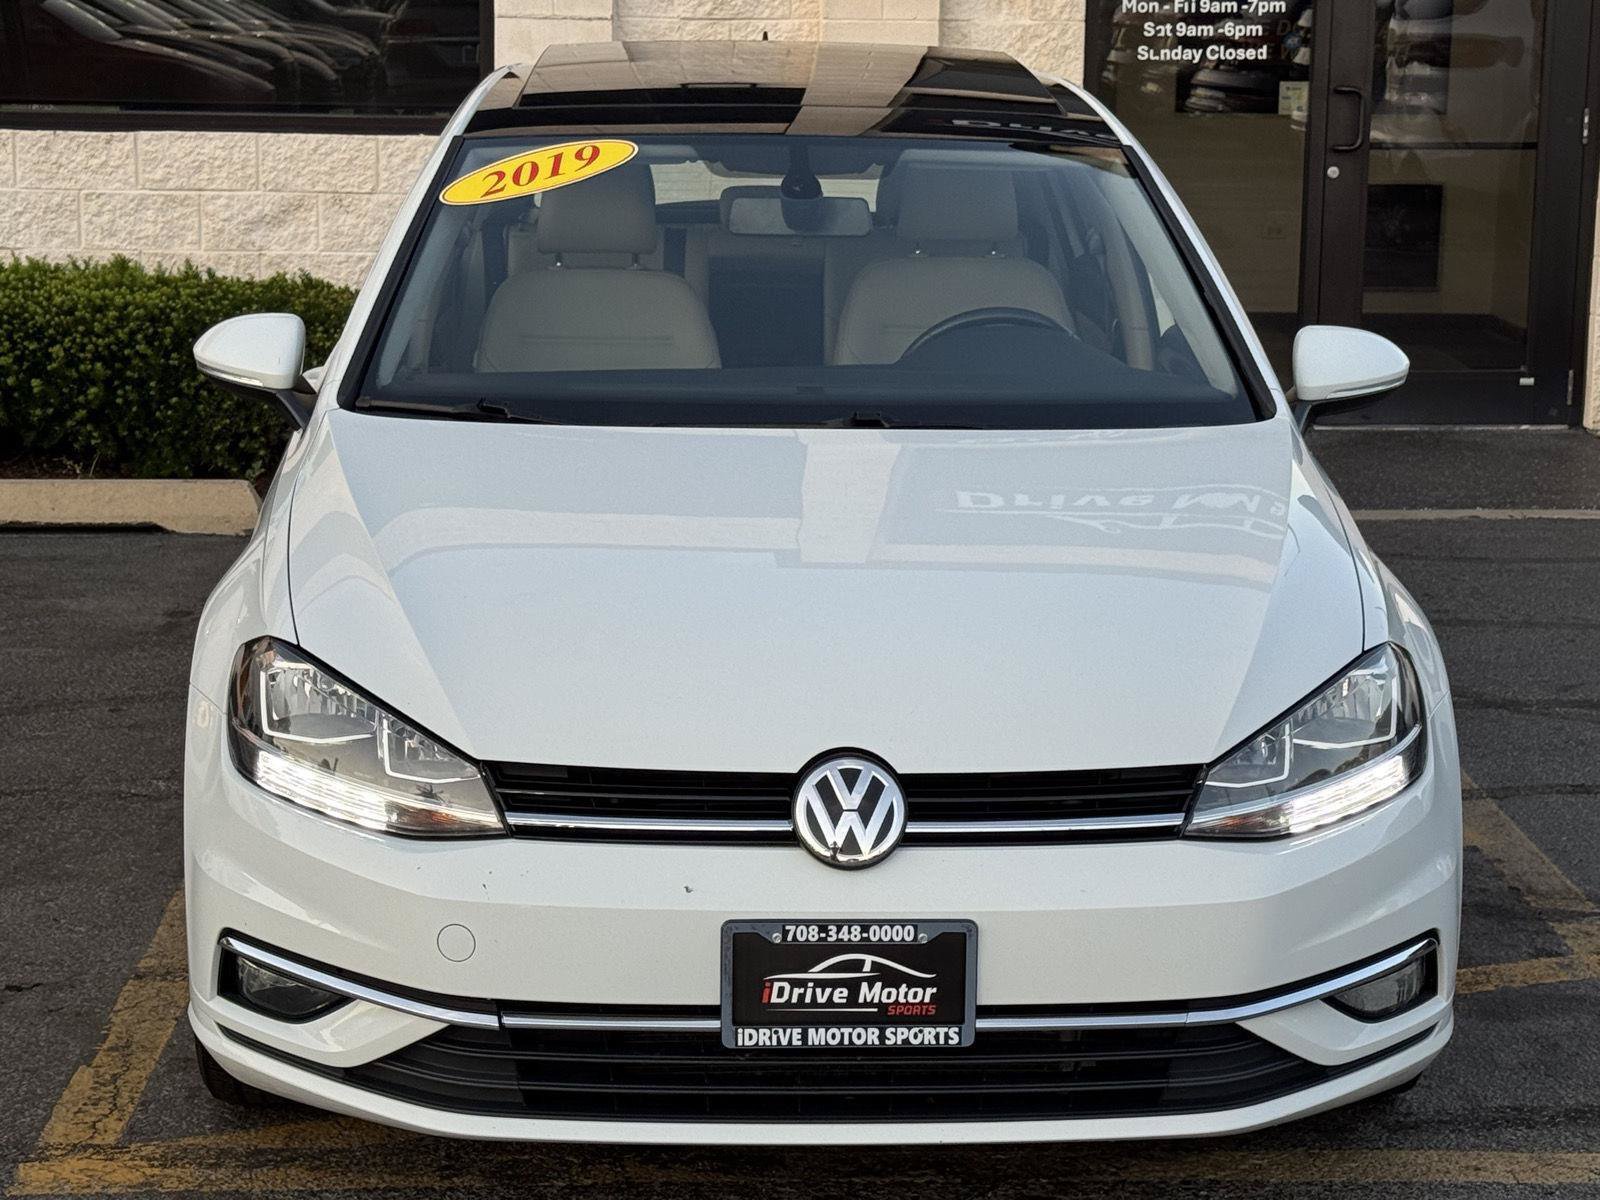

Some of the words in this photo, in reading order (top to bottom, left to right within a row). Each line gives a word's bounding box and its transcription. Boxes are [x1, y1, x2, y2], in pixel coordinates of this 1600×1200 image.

[1121, 0, 1160, 14] Mon
[1199, 0, 1238, 14] 9am
[1175, 21, 1215, 37] 9am
[1205, 44, 1268, 61] Closed
[480, 144, 601, 199] 2019
[785, 925, 915, 942] 708-348-0000
[761, 981, 849, 1004] iDrive
[858, 981, 938, 1004] Motor
[886, 1004, 937, 1016] SPORTS
[807, 1027, 880, 1046] MOTOR
[885, 1026, 960, 1046] SPORTS
